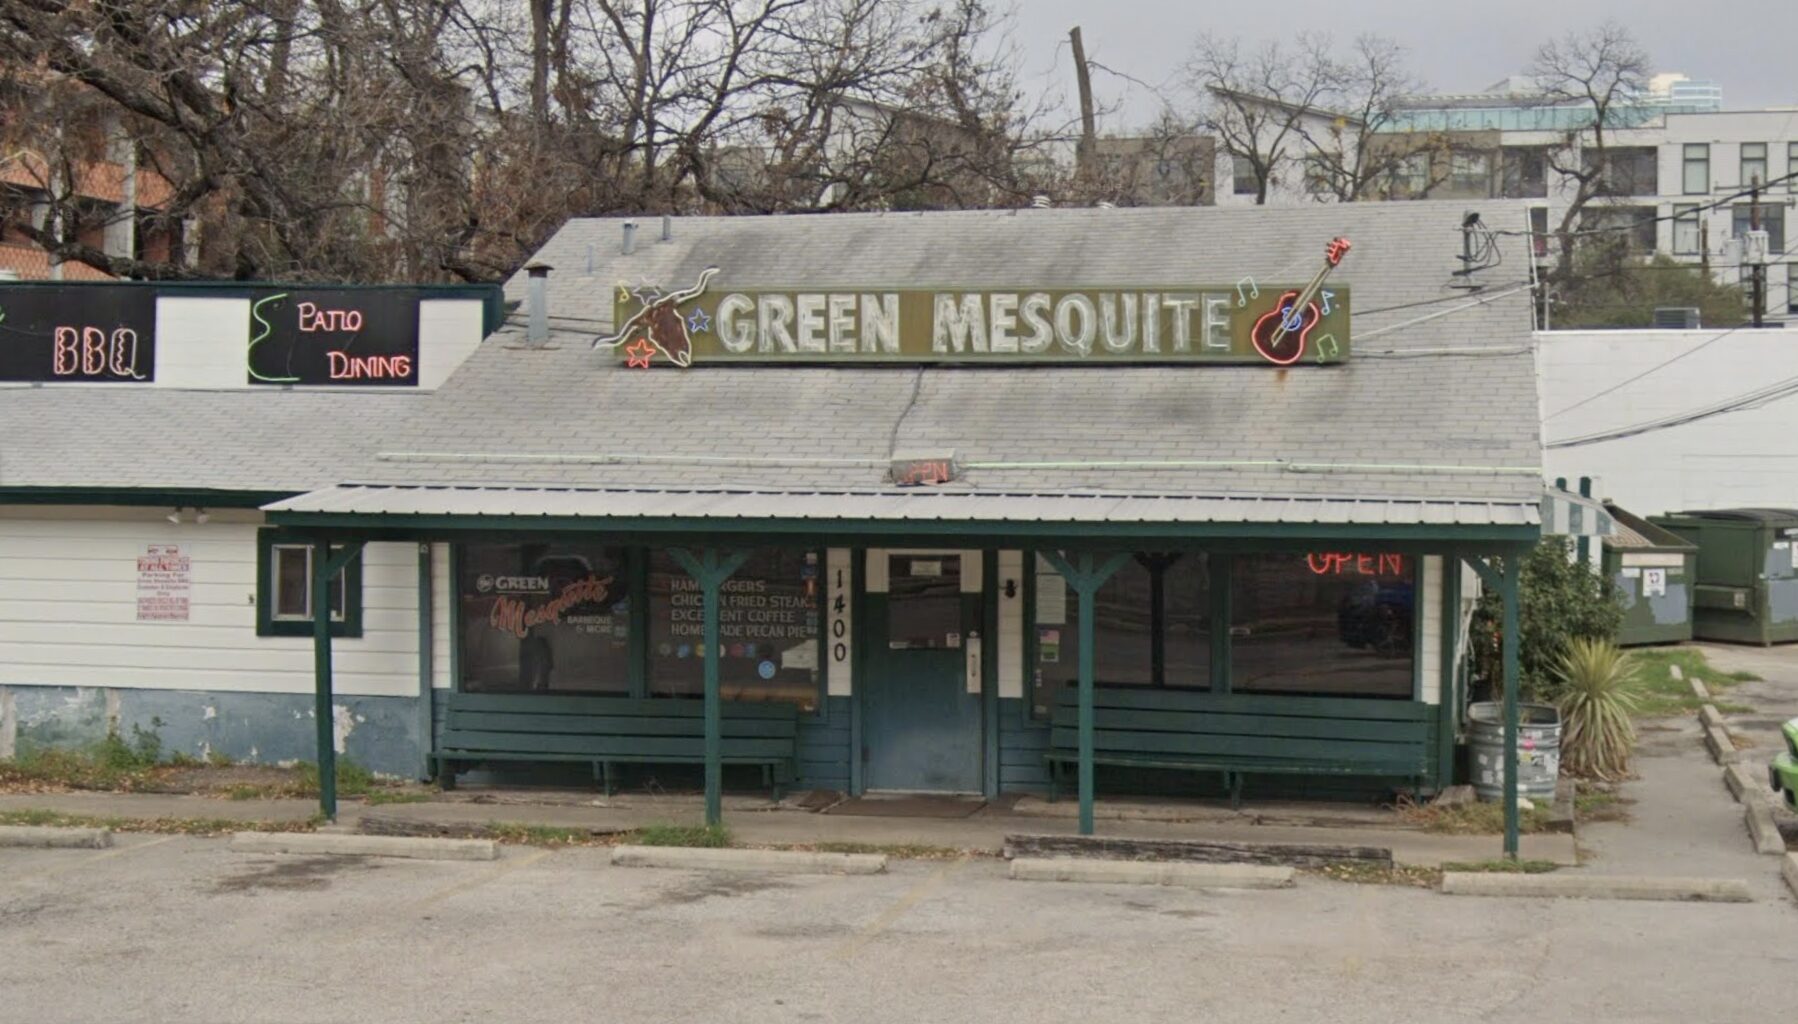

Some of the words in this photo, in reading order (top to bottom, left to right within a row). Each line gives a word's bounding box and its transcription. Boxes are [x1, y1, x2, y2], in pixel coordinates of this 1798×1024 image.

[715, 292, 900, 354] GREEN
[931, 292, 1232, 357] MESQUITE
[53, 326, 146, 380] BBQ
[1307, 553, 1402, 575] OPEN
[495, 576, 549, 590] GREEN
[729, 596, 767, 608] FRIED
[671, 609, 746, 622] EXCEENT
[747, 611, 796, 624] COFFEE
[832, 568, 847, 663] 1400
[671, 624, 744, 637] HOMEADE
[746, 625, 785, 638] PECAN
